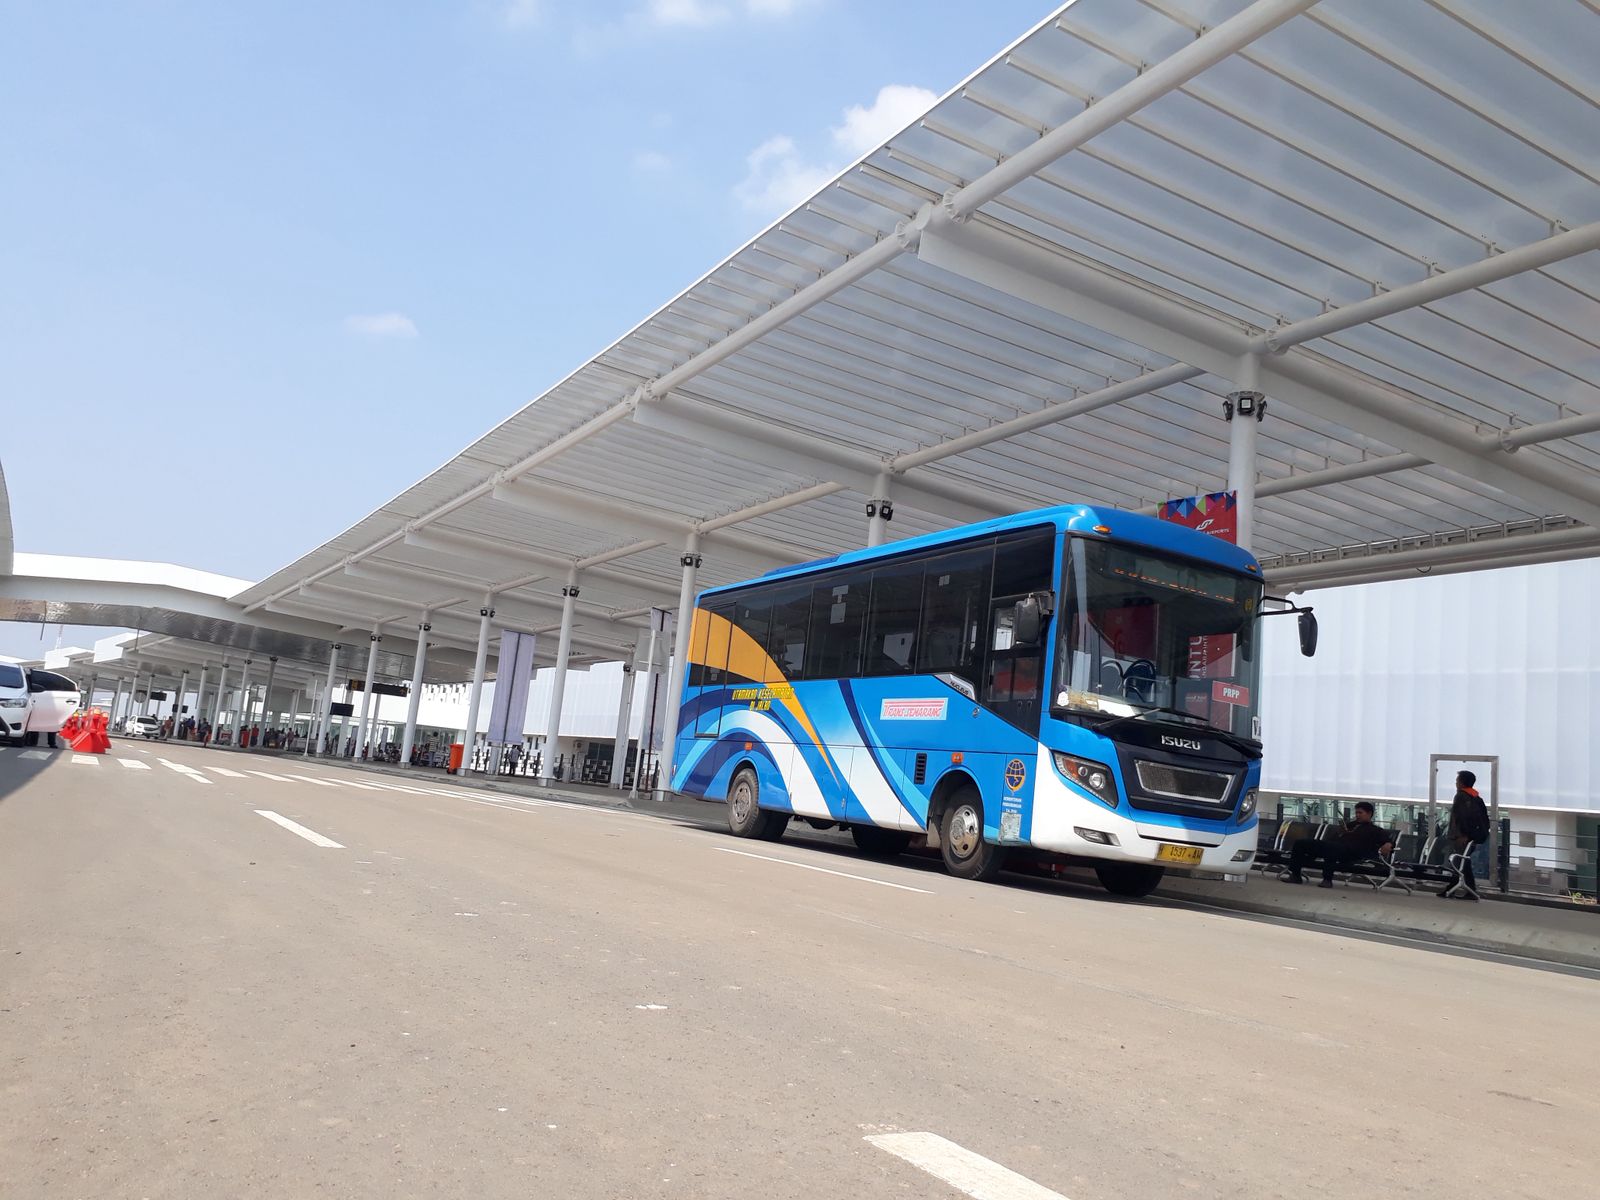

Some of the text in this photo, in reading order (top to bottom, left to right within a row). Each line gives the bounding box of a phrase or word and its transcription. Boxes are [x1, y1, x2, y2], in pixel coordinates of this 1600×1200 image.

[950, 681, 969, 696] NUCLEUS
[1222, 687, 1240, 699] PRPP
[1161, 735, 1201, 751] ISUZU
[1170, 846, 1187, 858] 1537
